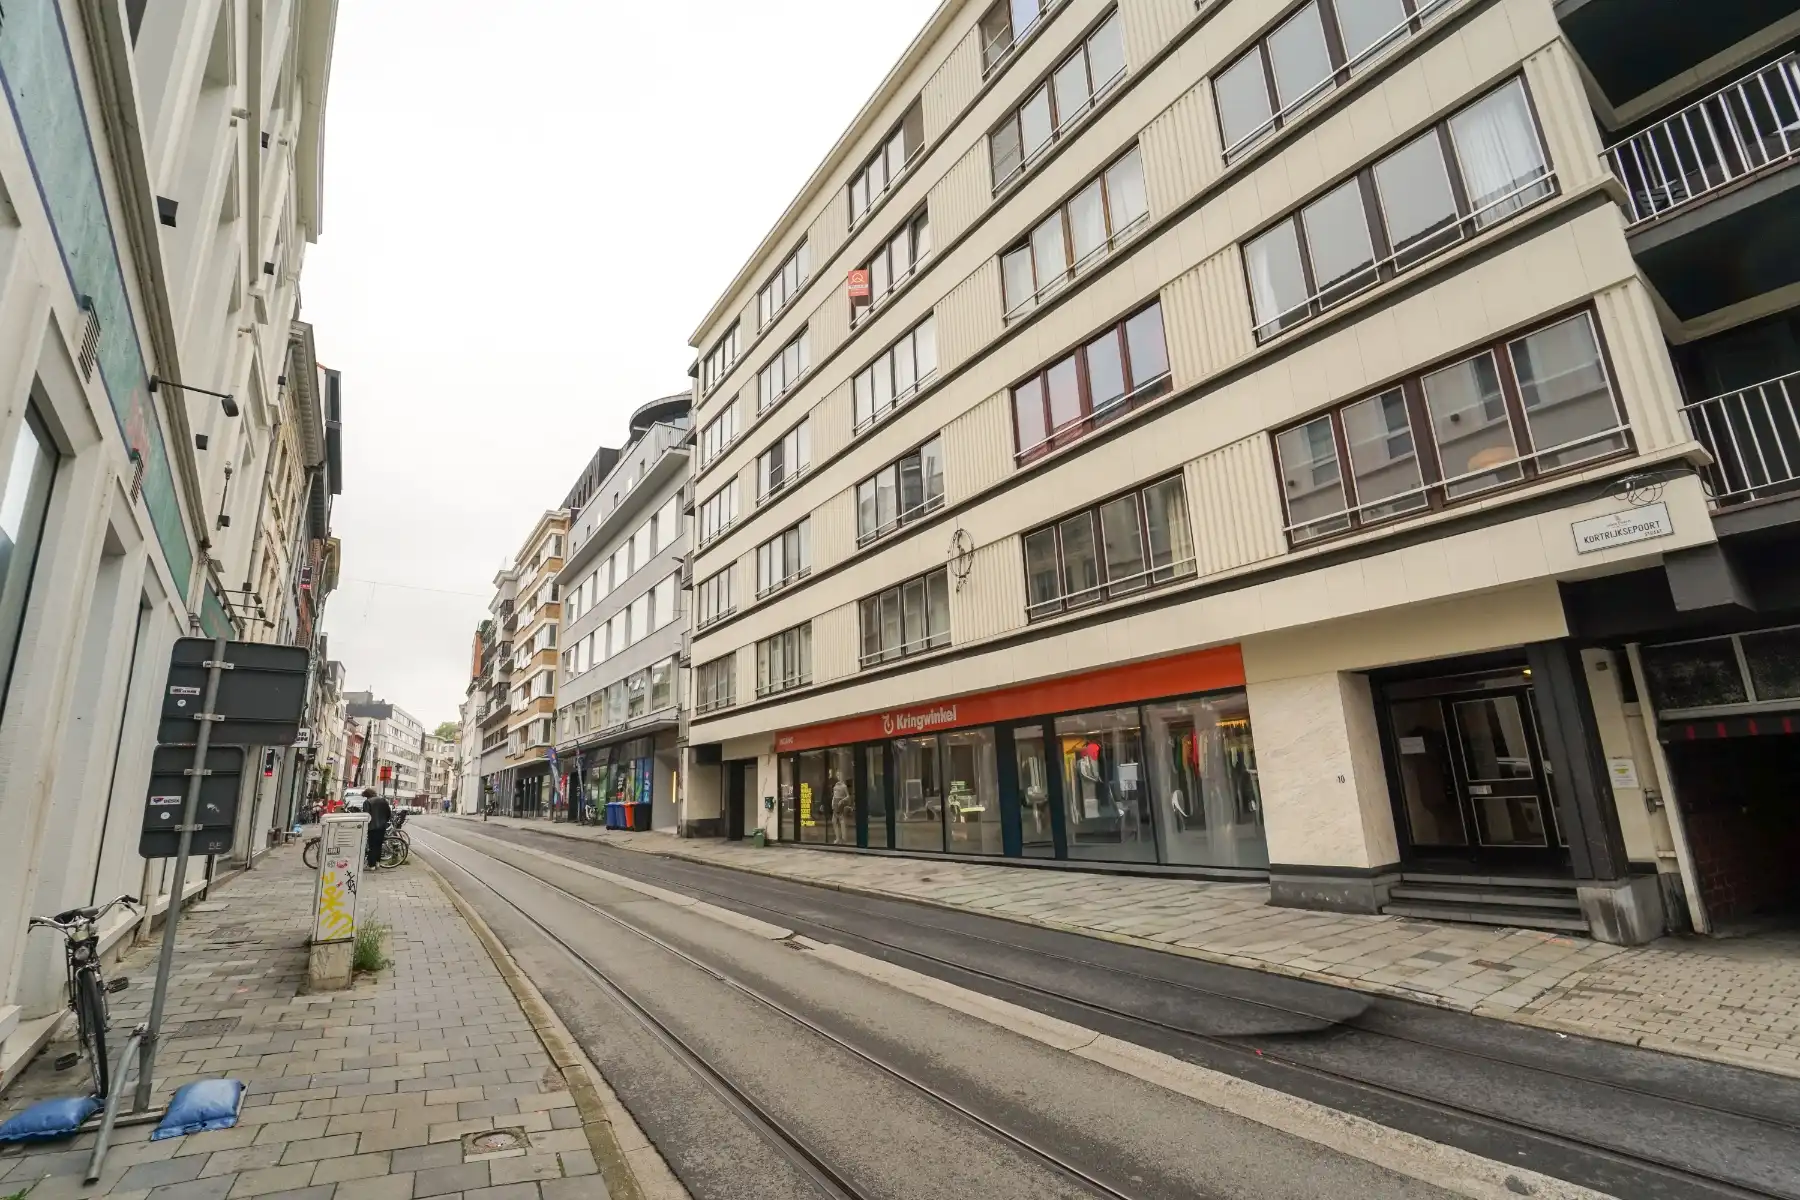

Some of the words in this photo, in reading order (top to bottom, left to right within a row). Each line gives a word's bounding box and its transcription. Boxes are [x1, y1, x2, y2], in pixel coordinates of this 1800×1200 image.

[1583, 520, 1661, 544] KORTRIJKSEPOORT
[896, 704, 957, 731] Kringwinkel
[1337, 774, 1346, 784] 10
